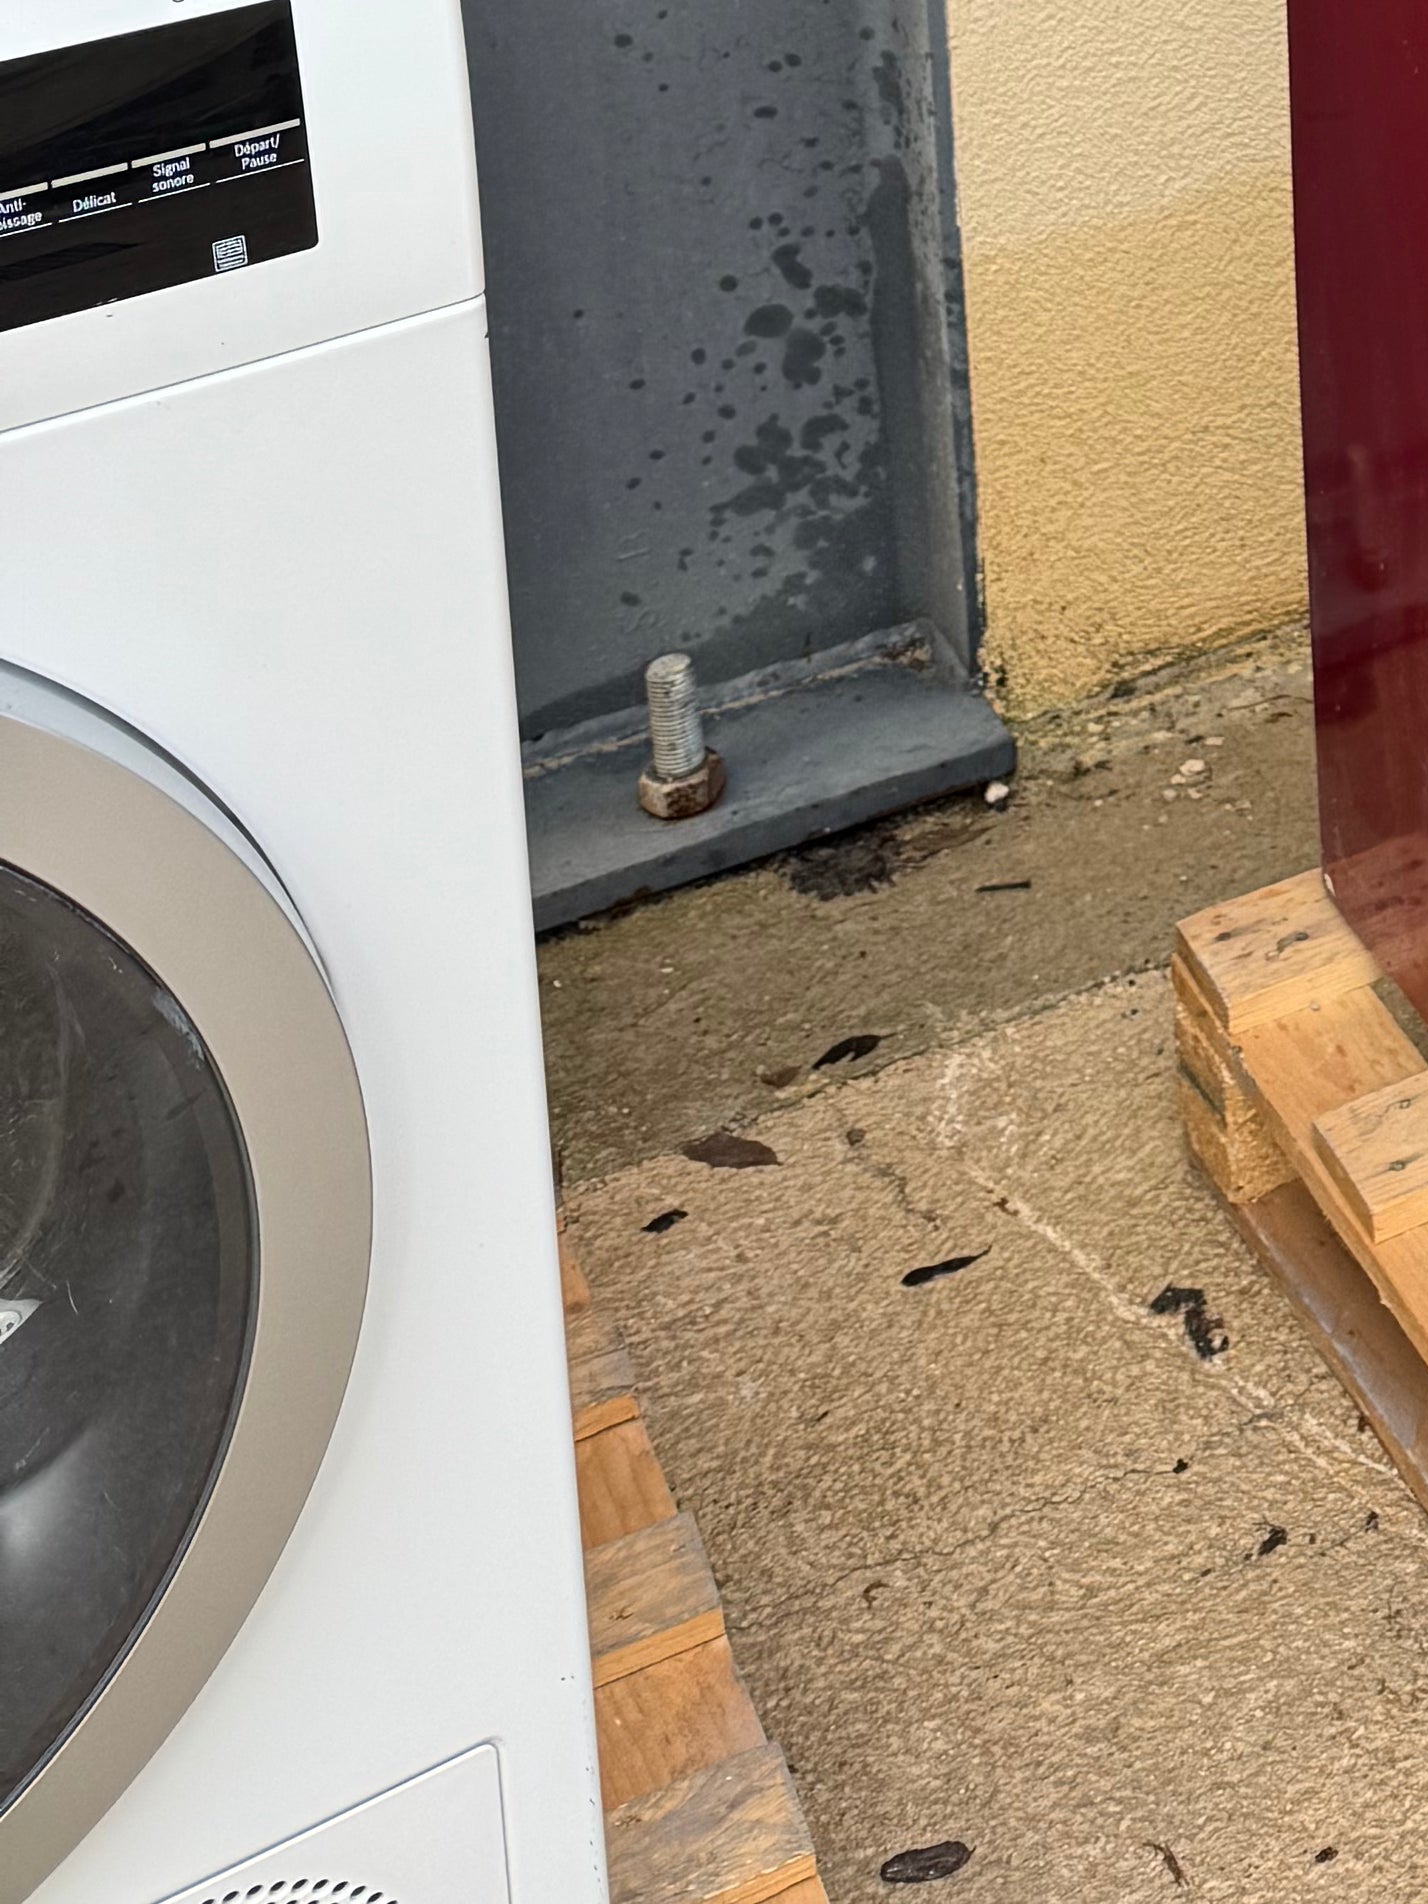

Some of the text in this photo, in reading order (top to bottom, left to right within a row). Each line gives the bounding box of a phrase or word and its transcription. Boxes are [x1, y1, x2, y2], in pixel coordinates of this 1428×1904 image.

[152, 156, 191, 178] Signal
[241, 152, 278, 171] Pause
[152, 173, 195, 193] sonore
[72, 192, 117, 213] Délicat
